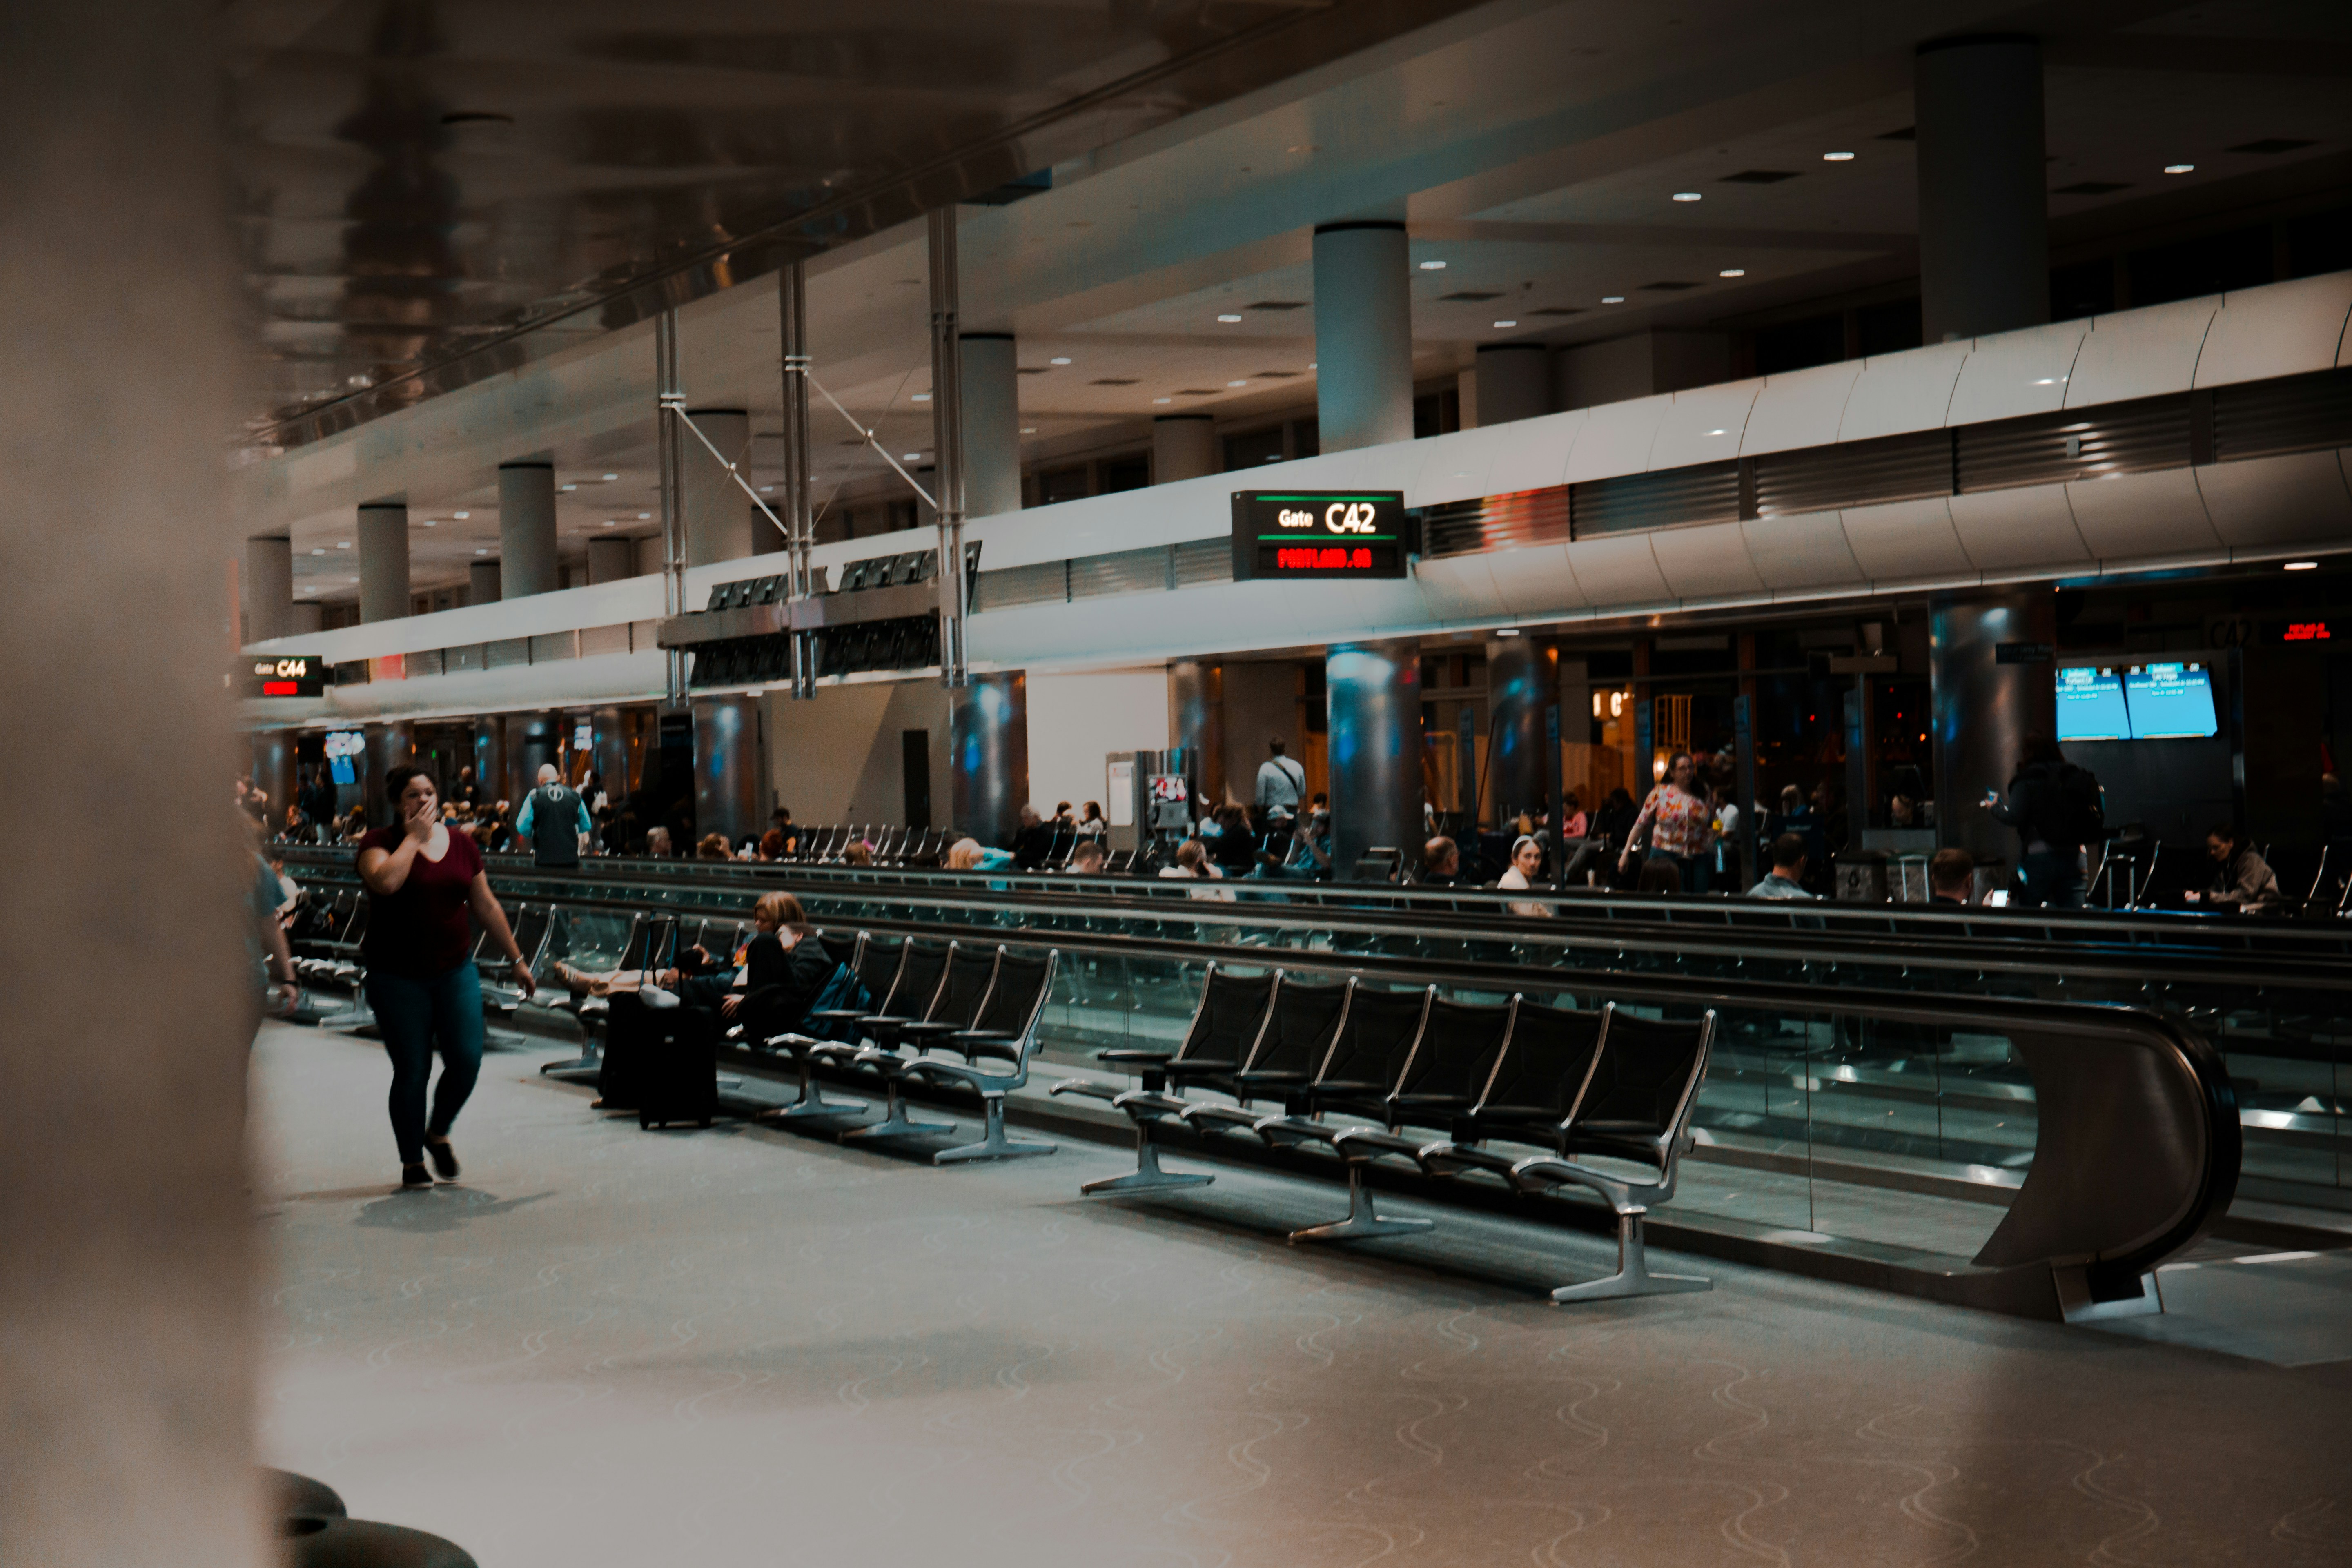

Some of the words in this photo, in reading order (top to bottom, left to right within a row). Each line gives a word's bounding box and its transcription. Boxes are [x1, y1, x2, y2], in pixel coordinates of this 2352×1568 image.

[1278, 509, 1314, 527] Gate
[1325, 503, 1376, 533] C42
[277, 659, 307, 677] C44
